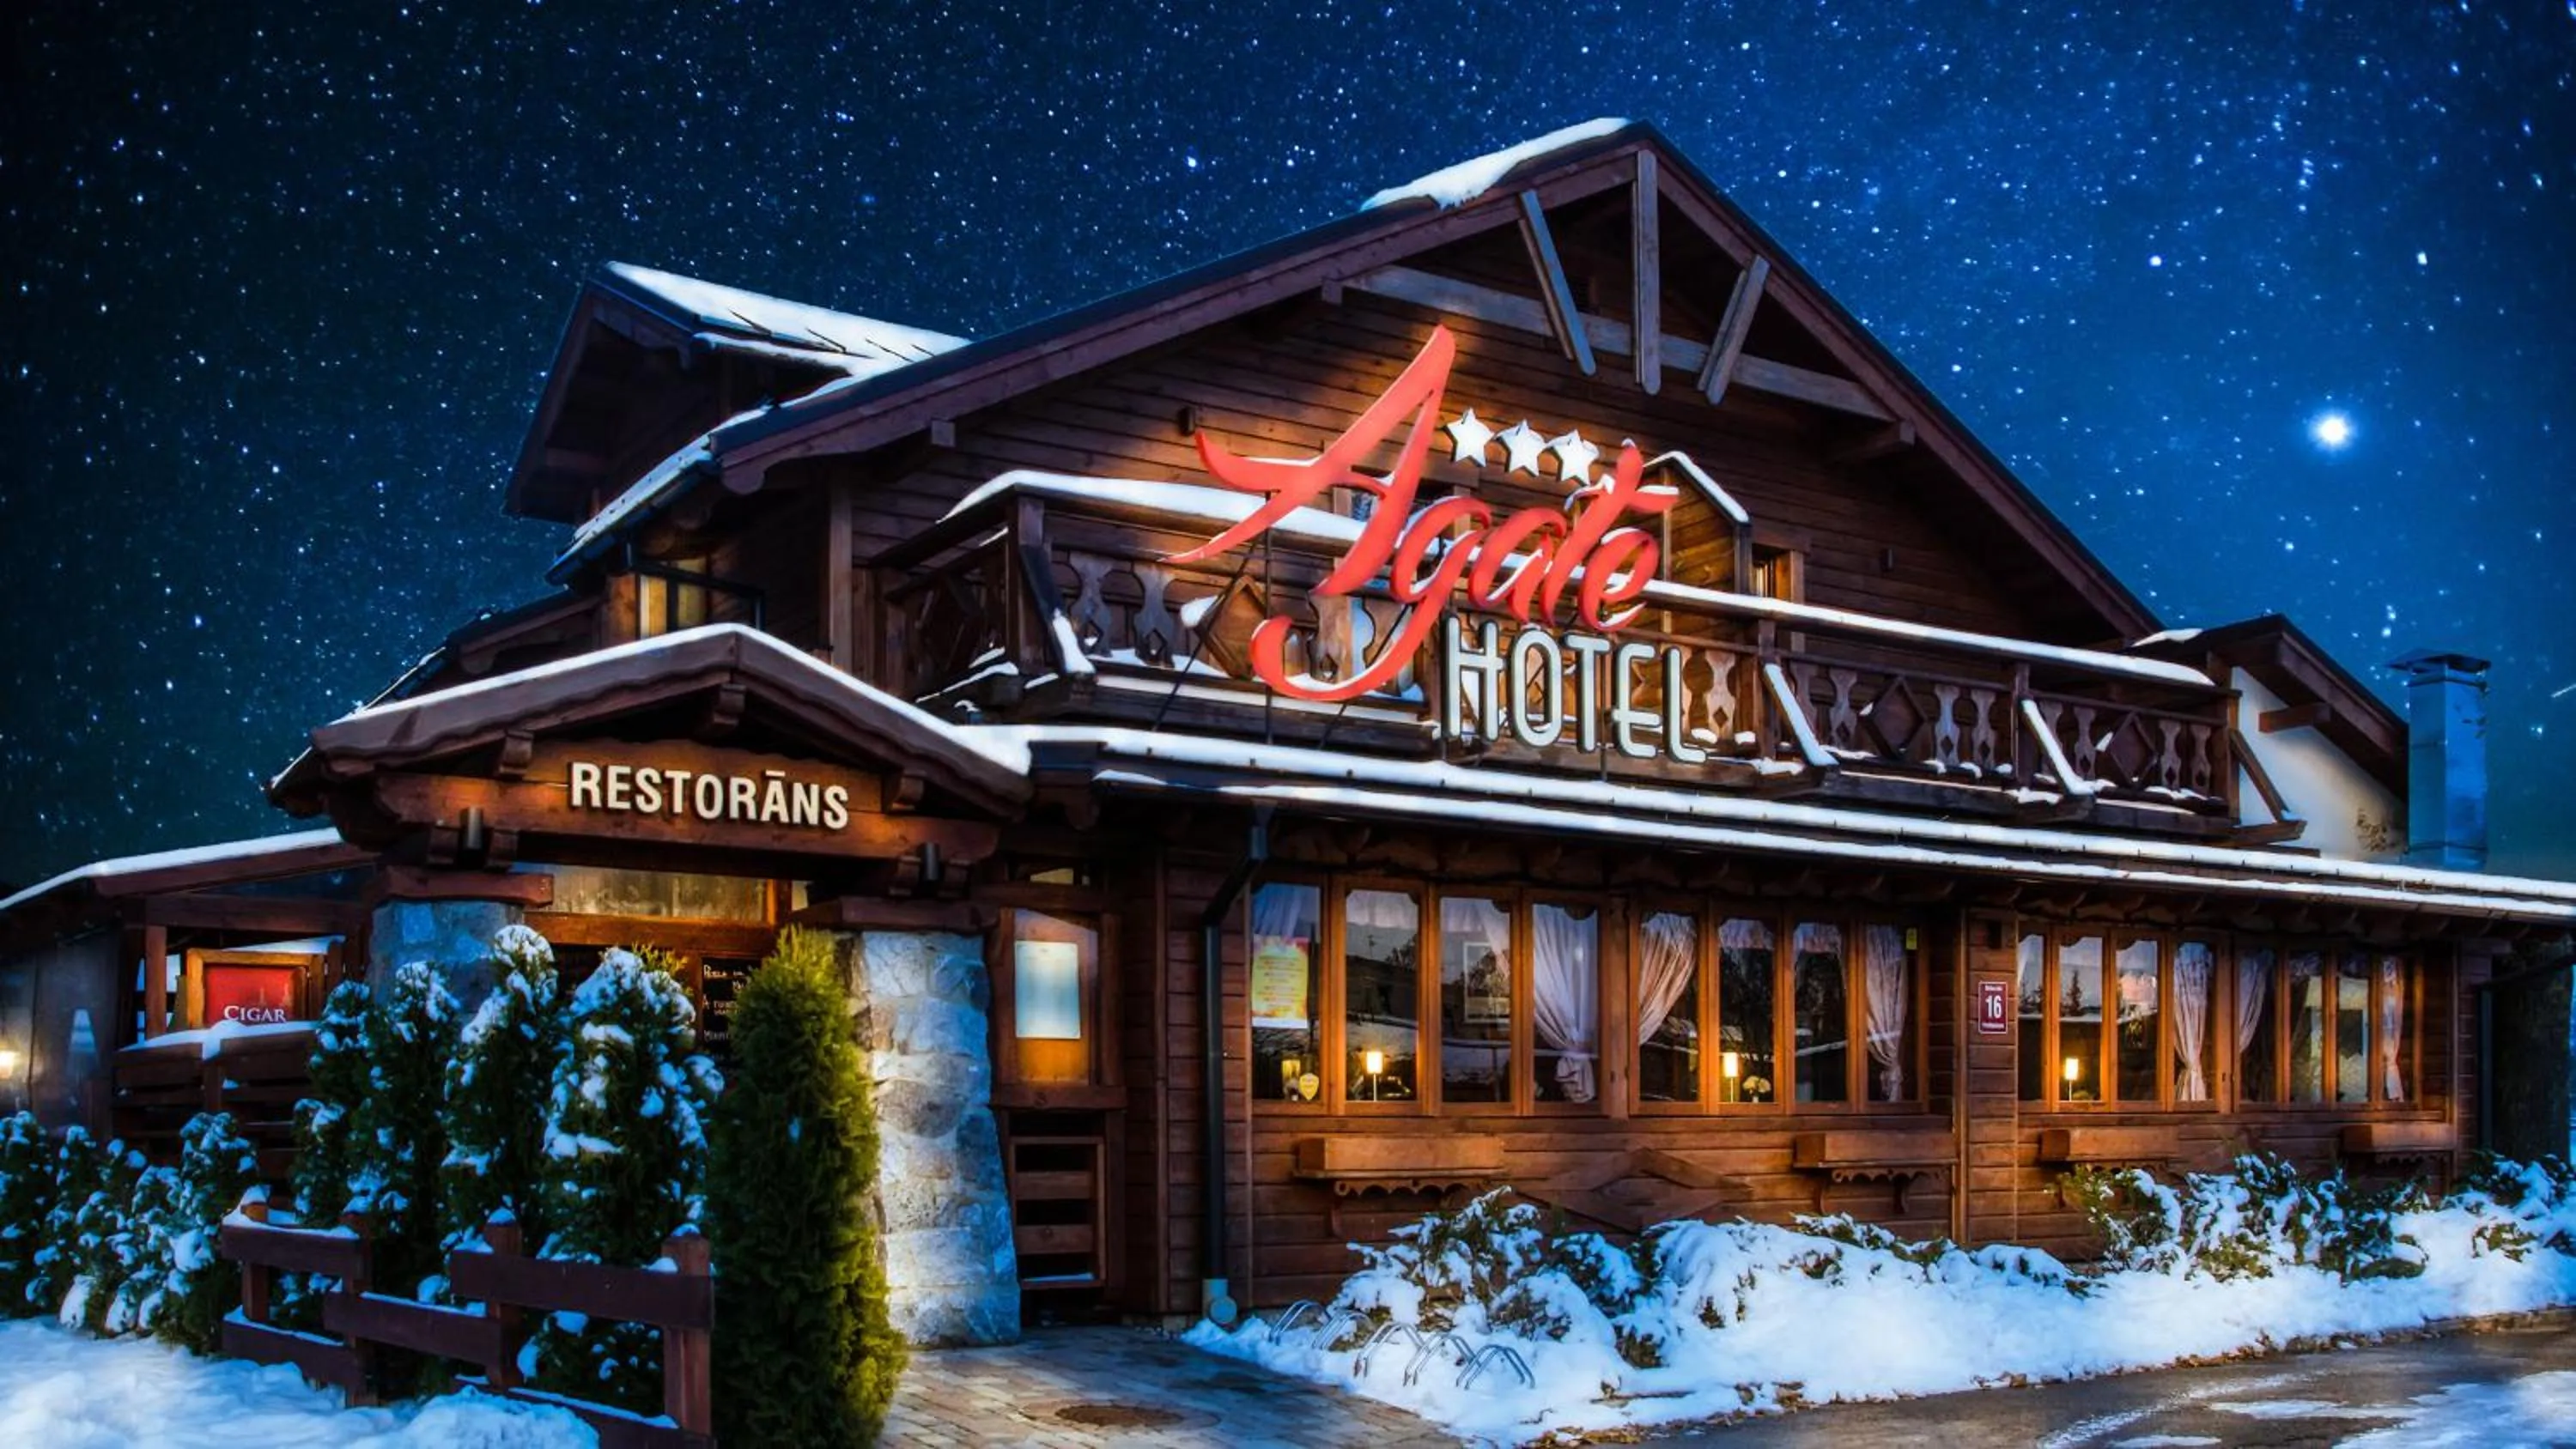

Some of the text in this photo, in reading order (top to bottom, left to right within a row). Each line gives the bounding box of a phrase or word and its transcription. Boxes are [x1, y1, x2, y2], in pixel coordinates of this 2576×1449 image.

[1157, 324, 1679, 702] Agate
[1443, 615, 1708, 763] HOTEL
[571, 762, 848, 830] RESTORĀNS
[223, 1005, 287, 1023] CIGAR
[1984, 995, 2002, 1019] 16
